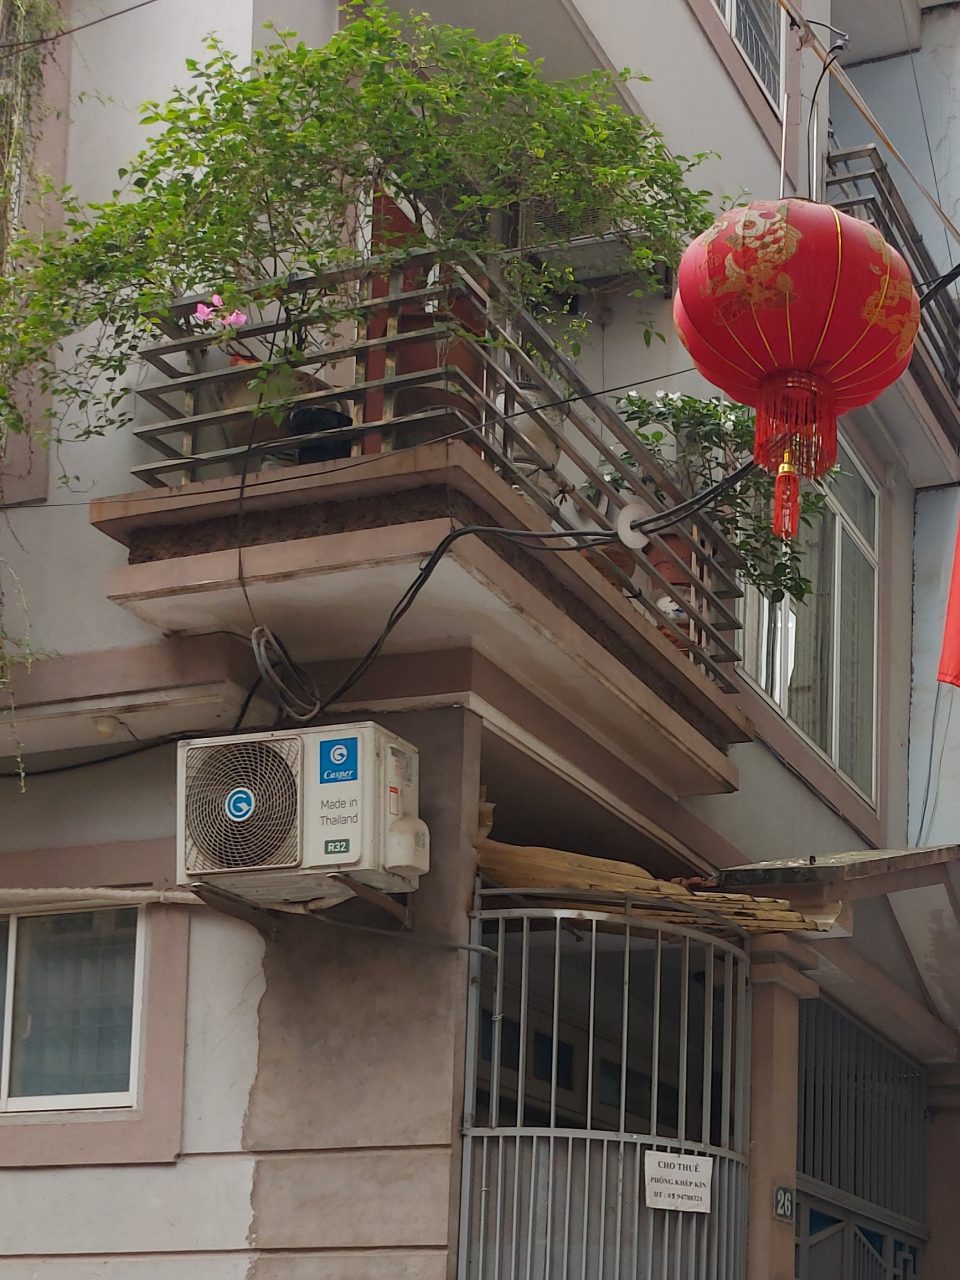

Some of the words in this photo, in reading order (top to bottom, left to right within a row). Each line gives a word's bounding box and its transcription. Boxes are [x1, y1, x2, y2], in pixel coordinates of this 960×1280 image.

[324, 769, 354, 781] Casper
[320, 798, 347, 810] Made
[349, 797, 358, 808] in
[319, 813, 359, 826] Thailand
[328, 841, 347, 853] R32
[658, 1160, 675, 1169] CHO
[677, 1163, 700, 1173] THUÊ
[777, 1189, 791, 1216] 26
